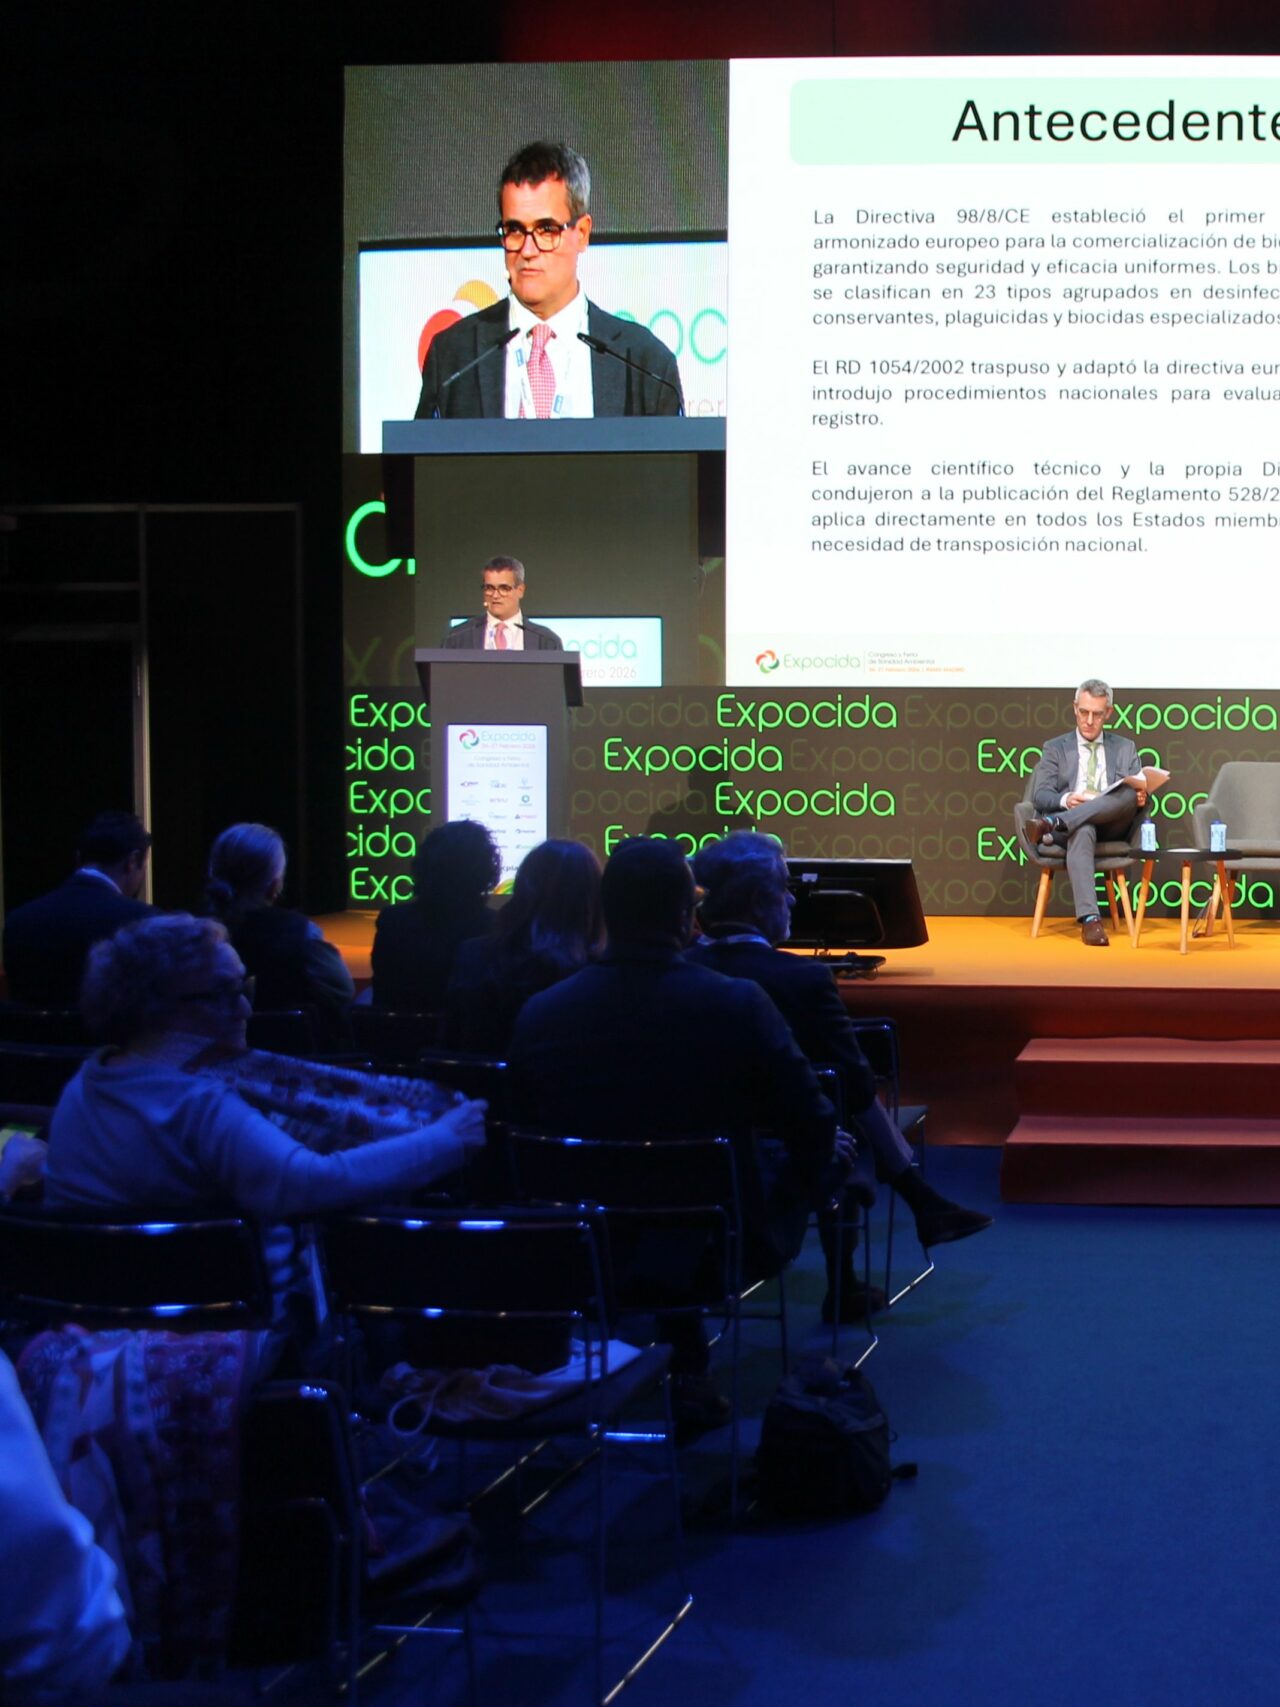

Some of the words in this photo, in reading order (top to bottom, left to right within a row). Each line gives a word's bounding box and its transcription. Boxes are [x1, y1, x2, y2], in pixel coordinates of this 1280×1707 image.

[814, 210, 834, 225] La
[856, 209, 935, 224] Directiva
[956, 208, 1028, 224] 98/8/CE
[1051, 208, 1146, 223] estableció
[1168, 208, 1184, 223] el
[1205, 212, 1265, 227] primer
[813, 234, 920, 250] armonizado
[925, 237, 1000, 252] europeo
[1005, 237, 1045, 252] para
[1051, 233, 1066, 249] la
[1072, 233, 1228, 249] comercialización
[1233, 234, 1256, 249] de
[812, 259, 929, 279] garantizando
[936, 259, 1025, 278] seguridad
[1030, 263, 1041, 277] y
[1046, 259, 1118, 274] eficacia
[1124, 259, 1222, 274] uniformes.
[1229, 259, 1260, 274] Los
[813, 288, 833, 300] se
[844, 284, 931, 300] clasifican
[941, 287, 964, 300] en
[974, 284, 996, 299] 23
[1006, 285, 1052, 303] tipos
[1062, 284, 1159, 303] agrupados
[1169, 287, 1192, 299] en
[812, 311, 939, 326] conservantes,
[945, 309, 1049, 328] plaguicidas
[1053, 313, 1063, 327] y
[1068, 309, 1145, 324] biocidas
[812, 359, 829, 375] El
[836, 359, 861, 375] RD
[870, 359, 964, 375] 1054/2002
[970, 361, 1050, 378] traspuso
[1056, 363, 1067, 378] y
[1072, 359, 1137, 378] adaptó
[1143, 359, 1159, 375] la
[1166, 360, 1244, 375] directiva
[812, 385, 893, 404] introdujo
[904, 385, 1047, 404] procedimientos
[1059, 385, 1158, 400] nacionales
[1171, 389, 1211, 404] para
[812, 412, 883, 429] registro.
[812, 460, 828, 476] El
[847, 464, 912, 476] avance
[930, 460, 1014, 476] científico
[1033, 461, 1102, 476] técnico
[1120, 464, 1130, 479] y
[1149, 461, 1165, 476] la
[1185, 464, 1242, 479] propia
[811, 486, 913, 504] condujeron
[921, 489, 931, 501] a
[939, 486, 955, 501] la
[962, 485, 1069, 504] publicación
[1076, 486, 1104, 501] del
[1112, 485, 1221, 505] Reglamento
[811, 511, 866, 530] aplica
[874, 511, 996, 527] directamente
[1004, 515, 1027, 527] en
[1036, 511, 1087, 527] todos
[1096, 511, 1123, 527] los
[1133, 511, 1205, 527] Estados
[811, 536, 904, 552] necesidad
[909, 536, 932, 552] de
[936, 537, 1060, 555] transposición
[1065, 537, 1148, 552] nacional.
[783, 653, 861, 672] Expocida
[716, 693, 898, 733] Expocida
[603, 737, 785, 777] Expocida
[789, 738, 971, 777] Expocida
[715, 781, 896, 821] Expocida
[789, 826, 971, 861] Expocida
